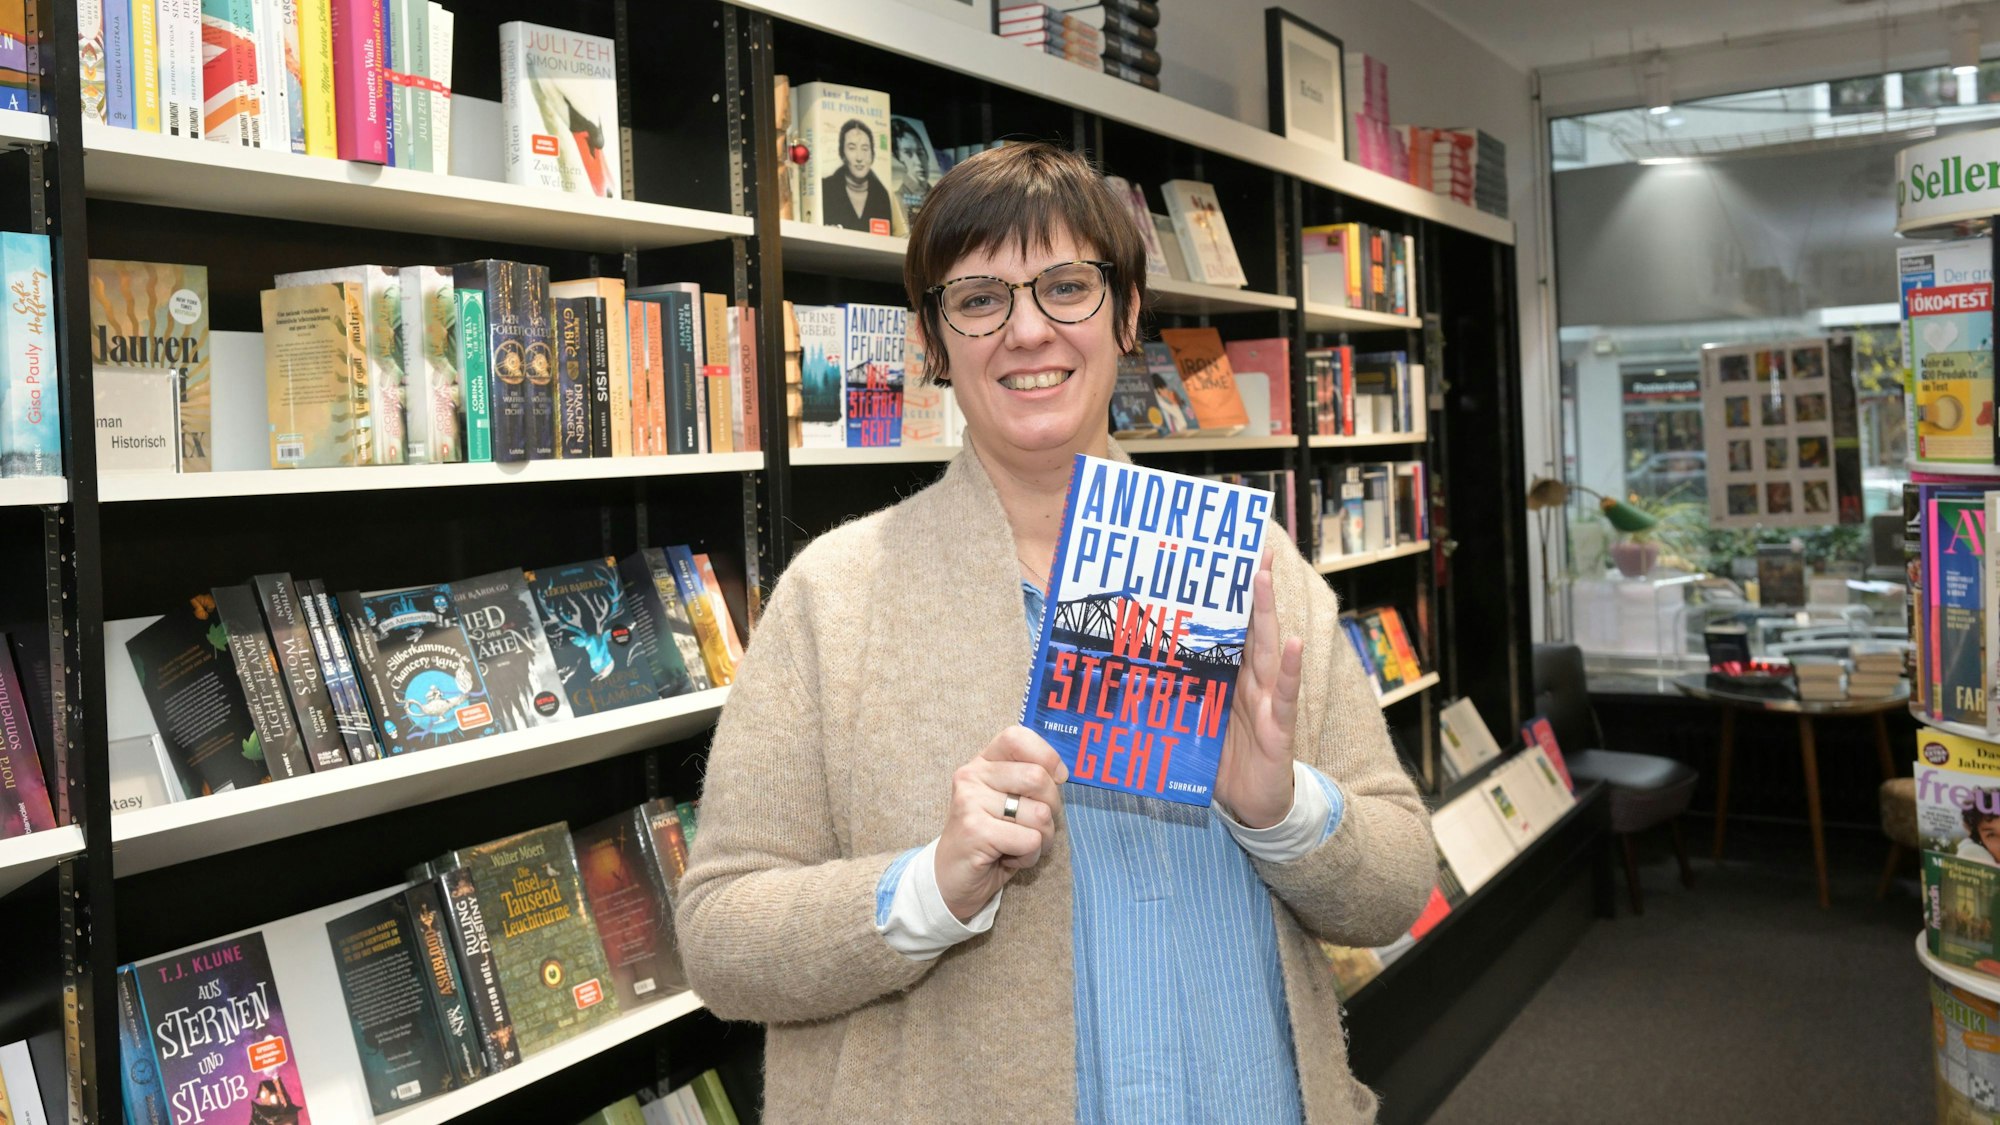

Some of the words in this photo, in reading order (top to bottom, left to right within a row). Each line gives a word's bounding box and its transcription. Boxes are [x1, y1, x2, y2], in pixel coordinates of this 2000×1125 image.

[364, 38, 374, 68] Walls
[374, 29, 382, 74] Himmel
[507, 40, 517, 75] URBAN
[527, 31, 567, 54] JULI
[573, 38, 611, 62] ZEH
[114, 58, 122, 98] LJUDMILA
[526, 53, 567, 71] SIMON
[570, 60, 611, 79] URBAN
[366, 70, 376, 124] Jeannette
[375, 76, 383, 99] Vom
[392, 87, 401, 111] ZEH
[114, 111, 127, 120] dtv
[169, 101, 179, 127] DUMONT
[417, 91, 427, 115] ZEH
[821, 101, 836, 111] DIE
[839, 103, 883, 117] POSTKARTE
[190, 107, 199, 131] DUMONT
[241, 114, 249, 140] DUMONT
[251, 118, 260, 141] DUMONT
[393, 111, 402, 138] JULI
[417, 116, 428, 141] JULI
[511, 125, 519, 165] Welten
[533, 159, 582, 176] Zwischen
[540, 174, 576, 190] Welten
[1944, 269, 1968, 284] Der
[29, 268, 48, 335] Hoffnung
[349, 304, 361, 343] matrix
[801, 324, 836, 336] GBERG
[851, 306, 906, 335] ANDREAS
[97, 324, 199, 364] lauren
[852, 335, 905, 363] PFLÜGER
[24, 343, 42, 385] Pauly
[866, 363, 890, 391] WIE
[1180, 356, 1220, 377] IRON
[1921, 358, 1940, 368] Mehr
[1942, 358, 1955, 367] als
[1937, 369, 1978, 380] Produkte
[477, 375, 485, 415] BOMANN
[596, 371, 607, 402] SISI
[1184, 374, 1229, 392] FLAME
[1932, 382, 1948, 392] Test
[28, 388, 42, 424] Gisa
[565, 389, 576, 445] BANNER
[573, 384, 584, 443] DRACHEN
[849, 391, 901, 418] STERBEN
[96, 416, 122, 428] man
[861, 419, 891, 447] GEHT
[111, 435, 166, 449] Historisch
[1081, 464, 1268, 552] ANDREAS
[678, 558, 689, 578] Iron
[1072, 526, 1254, 614] PFLÜGER
[684, 579, 692, 590] of
[271, 593, 283, 617] RYAN
[275, 579, 295, 626] ANTHONY
[689, 590, 703, 617] Chain
[464, 606, 506, 631] IED
[313, 627, 330, 661] einsame
[327, 624, 344, 658] einsame
[478, 626, 536, 660] ÄHEN
[1113, 598, 1193, 668] WIE
[231, 634, 255, 692] ARMENTROUT
[241, 633, 266, 683] FLAME
[258, 639, 274, 677] SCHATTEN
[281, 638, 309, 697] WOLFES
[298, 648, 316, 681] LIED
[324, 660, 336, 676] Der
[338, 658, 349, 673] Der
[386, 643, 457, 672] Silberkammer
[270, 678, 277, 688] IM
[390, 657, 430, 690] Chancery
[273, 689, 284, 710] LIEBE
[1048, 652, 1228, 738] STERBEN
[1956, 686, 1986, 713] FAR
[254, 702, 272, 743] JENNIFER
[261, 692, 283, 738] LIGHT
[280, 711, 291, 729] EINE
[308, 705, 321, 732] KLINGE
[315, 709, 327, 733] RABEN
[1043, 720, 1078, 735] THRILLER
[1074, 721, 1179, 793] GEHT
[0, 756, 16, 789] nora
[1168, 780, 1208, 794] SUHRKAMP
[1917, 769, 2000, 816] freu
[111, 794, 143, 811] tasy
[490, 851, 518, 868] Walter
[519, 843, 546, 859] Moers
[512, 872, 540, 896] Insel
[517, 866, 530, 879] Die
[501, 879, 562, 918] Tausend
[454, 898, 481, 956] RULING
[467, 894, 491, 952] DESTINY
[502, 903, 571, 938] Leuchttürme
[192, 945, 244, 975] KLUNE
[423, 928, 452, 996] ASHBLOOD
[479, 960, 494, 984] NOËL
[198, 978, 222, 1001] AUS
[487, 985, 504, 1022] ALYSON
[156, 981, 270, 1060] STERNEN
[198, 1051, 224, 1075] UND
[172, 1074, 249, 1125] STAUB
